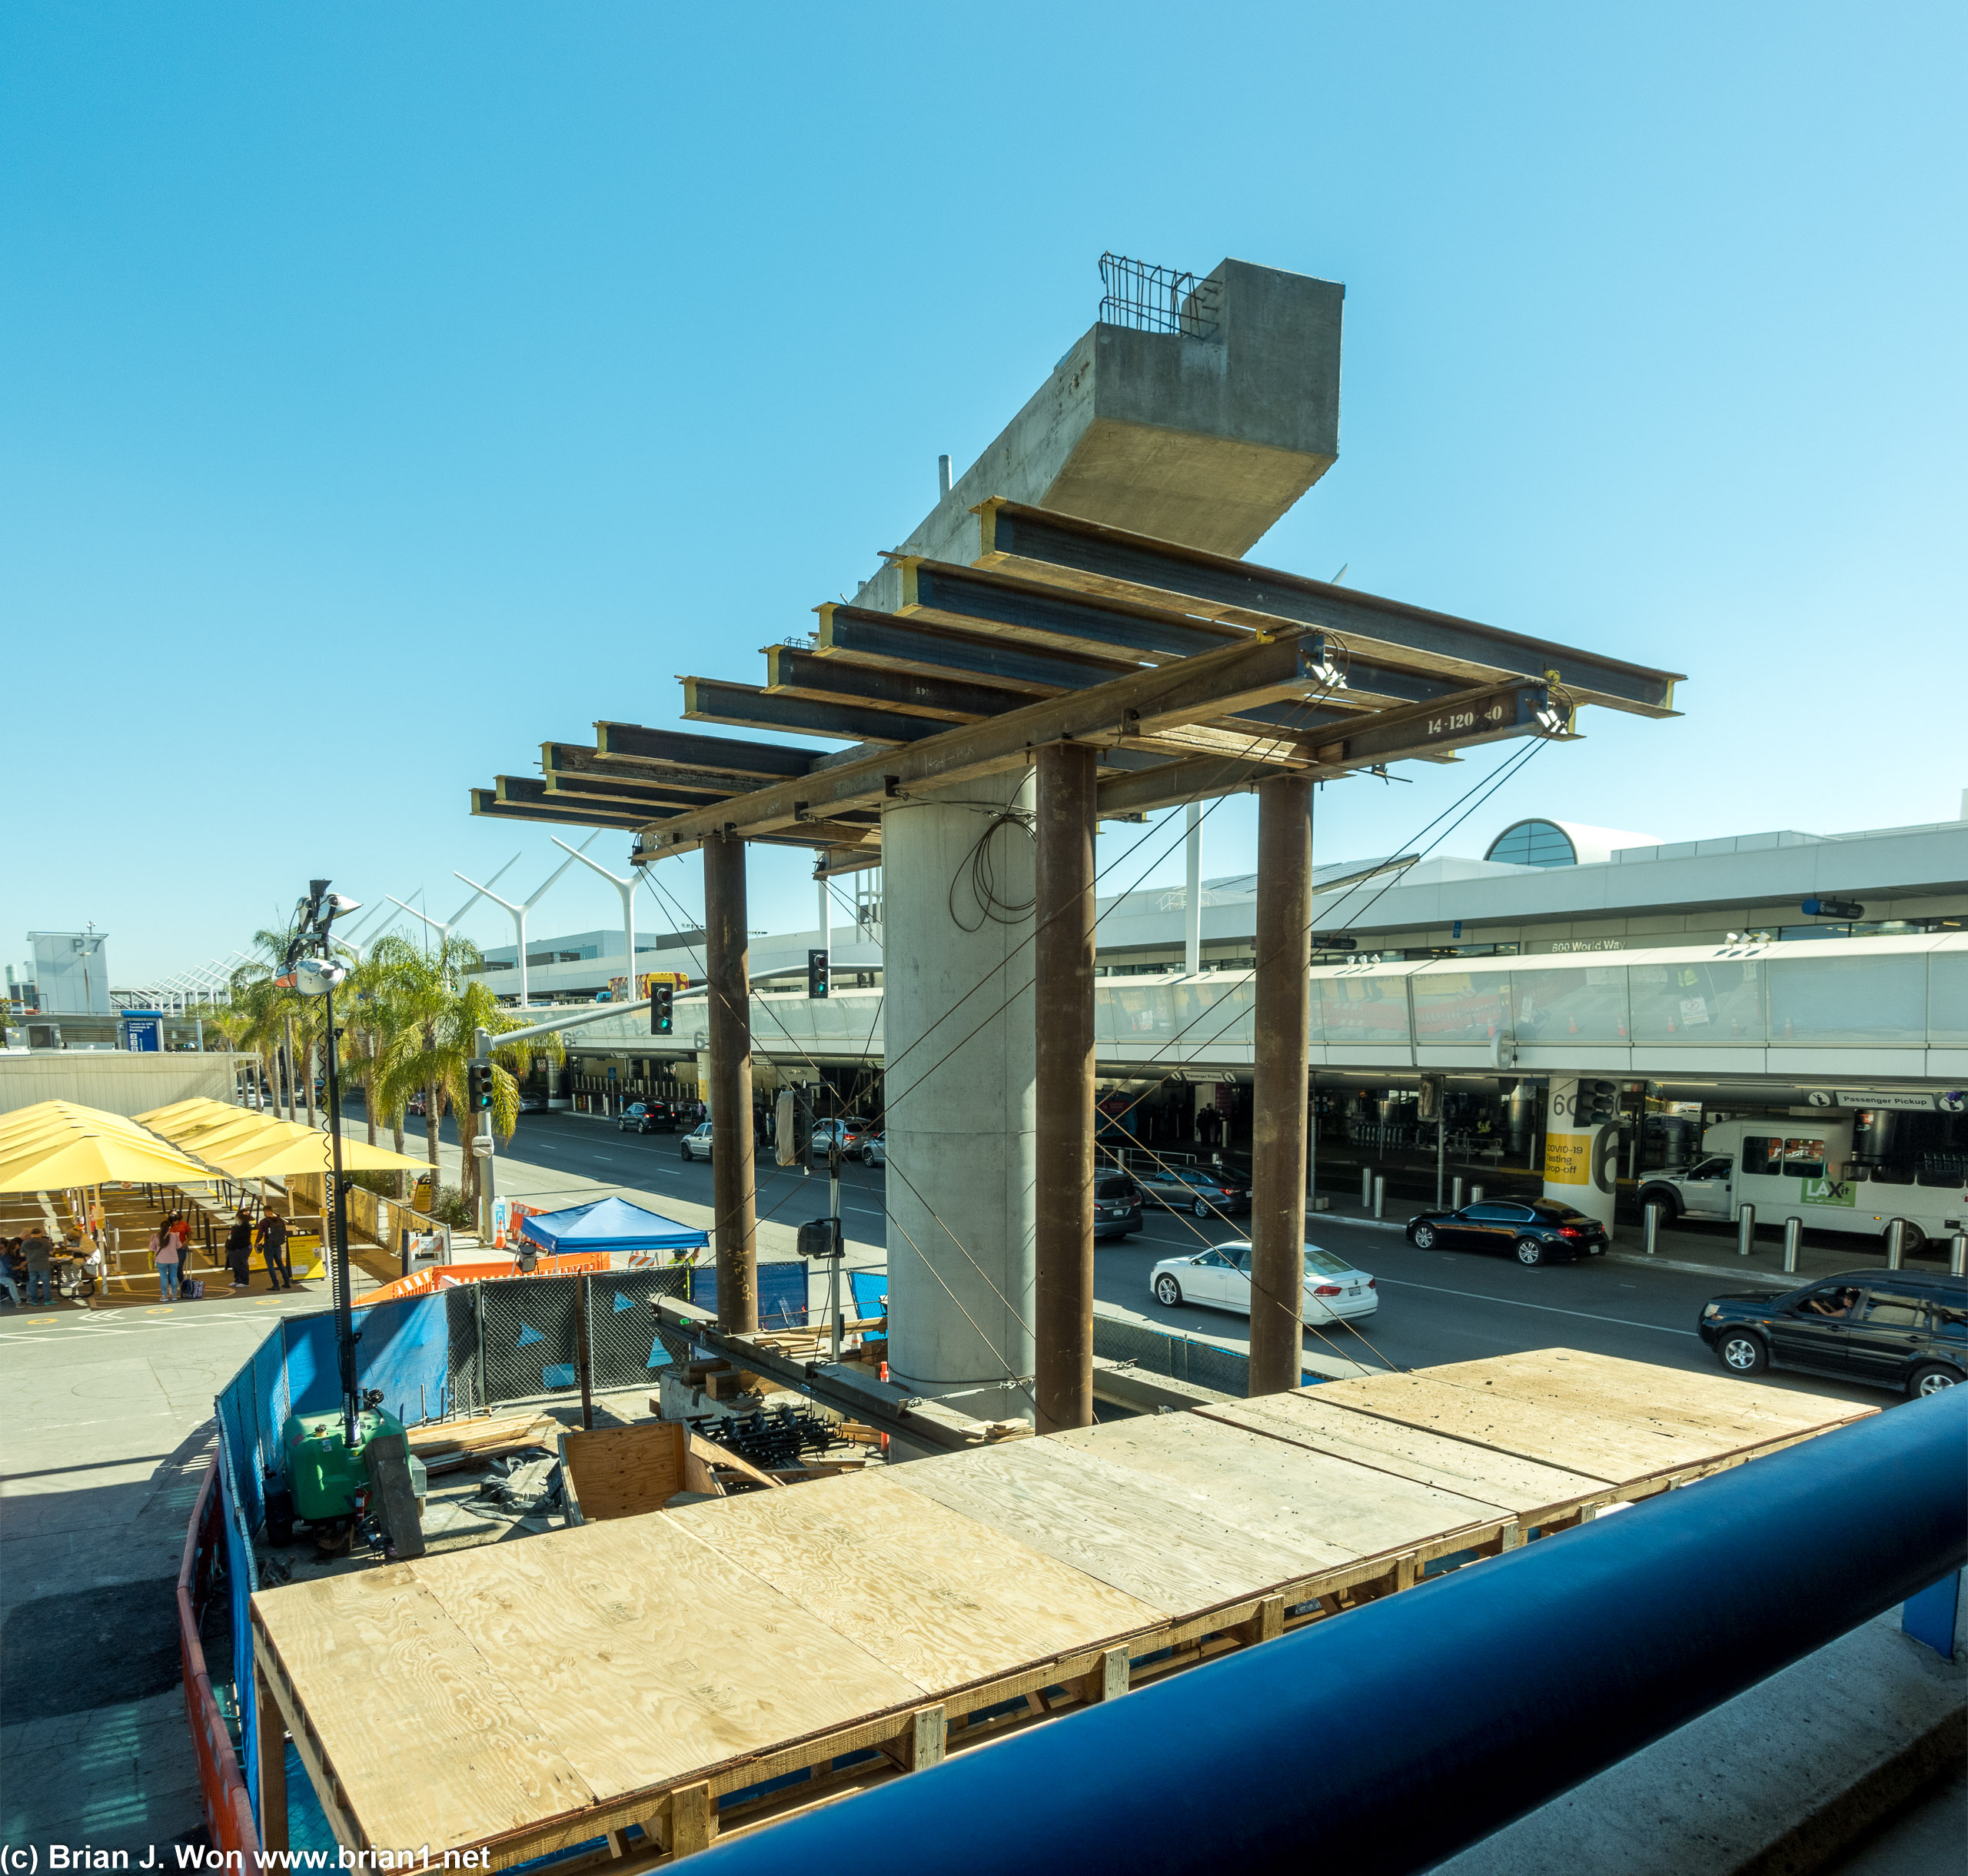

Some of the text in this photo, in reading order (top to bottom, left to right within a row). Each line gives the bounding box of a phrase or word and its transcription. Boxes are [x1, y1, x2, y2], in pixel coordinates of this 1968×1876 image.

[72, 939, 101, 953] P 7
[1552, 940, 1625, 953] 600 World Way
[694, 1031, 706, 1050] 6
[1491, 1029, 1513, 1070] 6
[1843, 1096, 1891, 1105] Passenger
[1547, 1143, 1583, 1154] COVID-19
[1547, 1153, 1572, 1166] Testing
[1546, 1163, 1577, 1174] Drop-off
